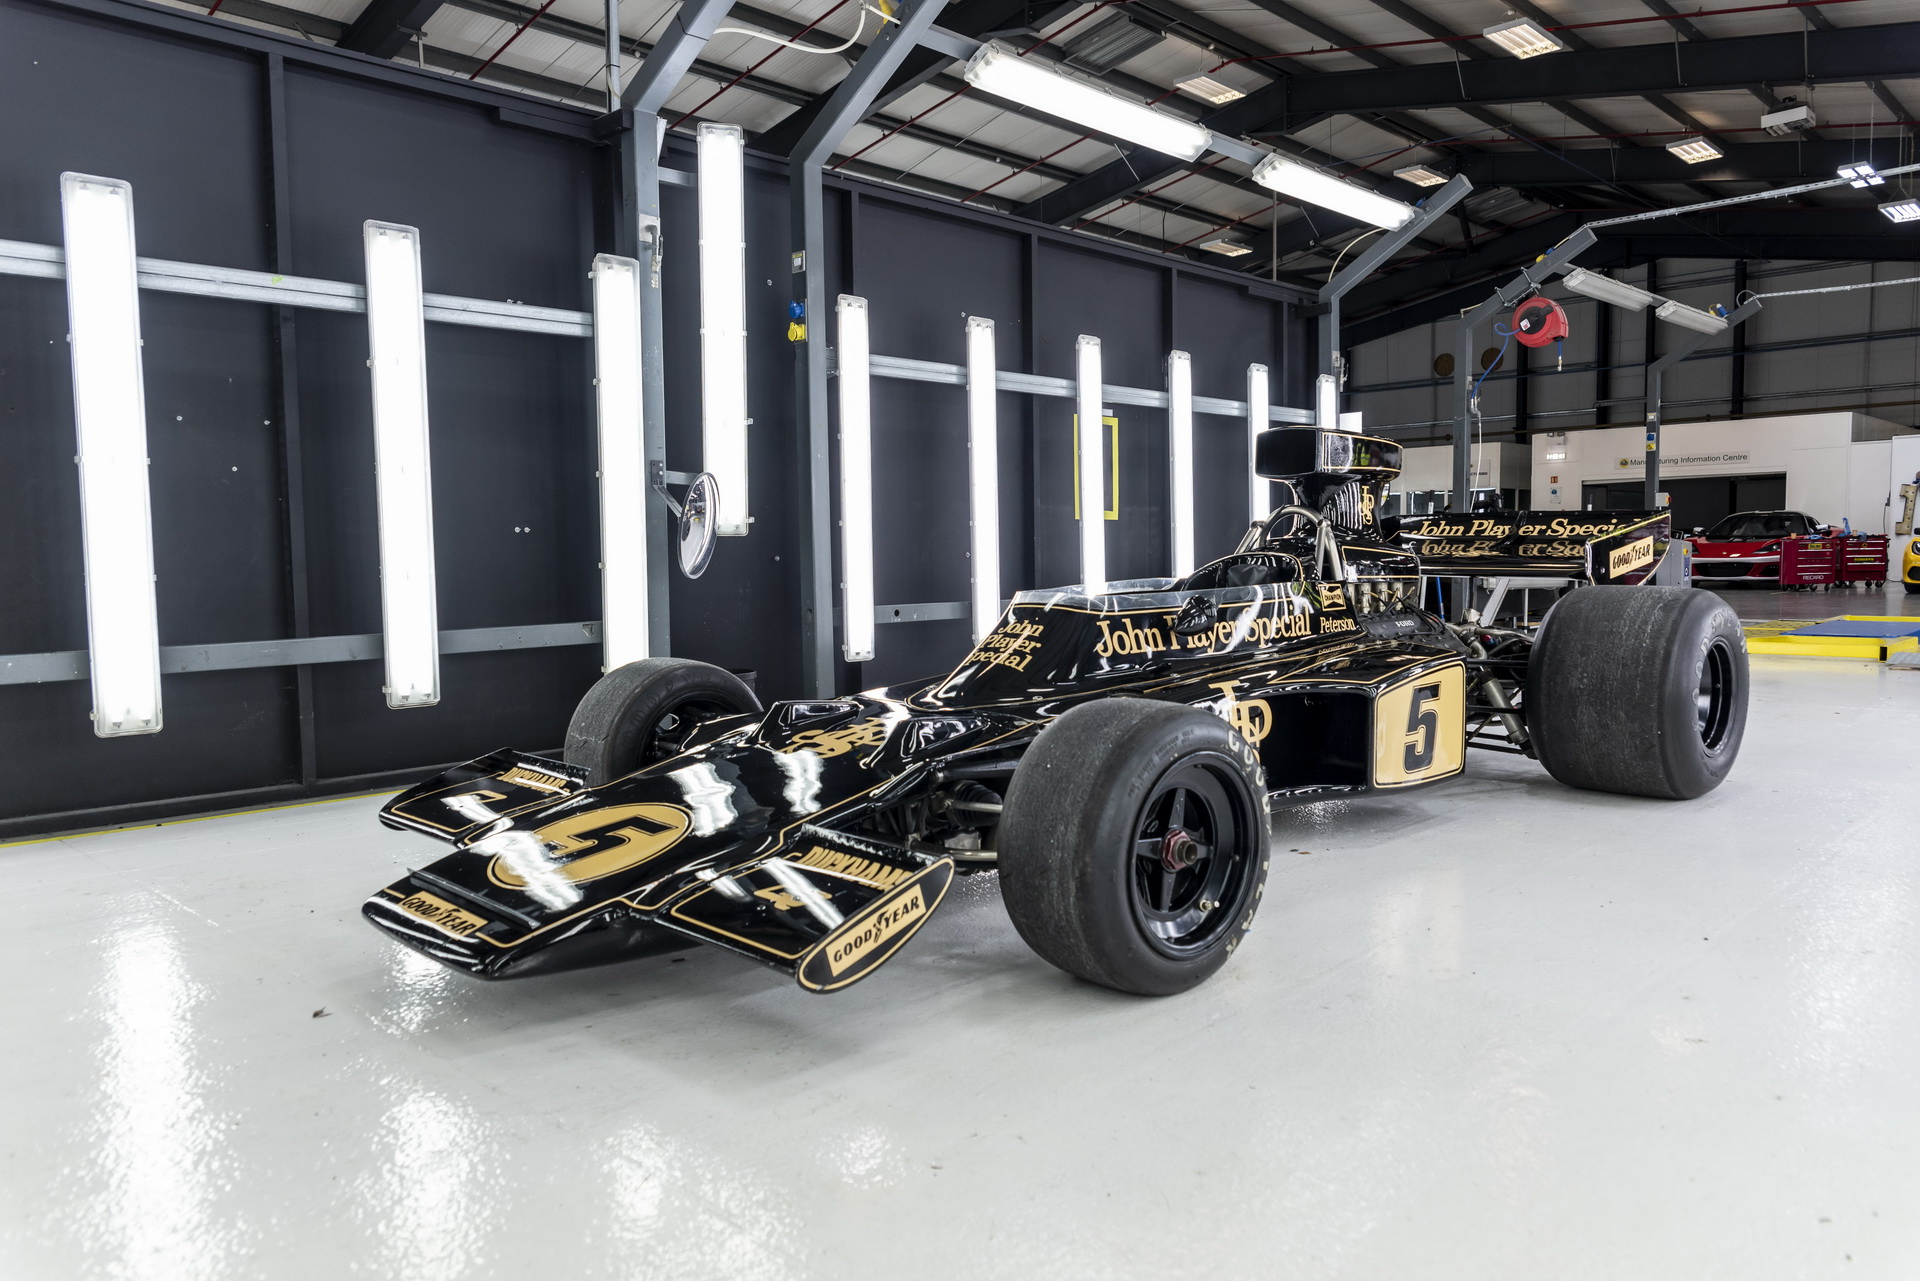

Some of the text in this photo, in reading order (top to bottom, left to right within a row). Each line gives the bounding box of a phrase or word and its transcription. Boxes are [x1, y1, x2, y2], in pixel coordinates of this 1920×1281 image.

[1630, 454, 1748, 466] Manturing Information Centre
[1411, 520, 1465, 537] John
[1546, 518, 1642, 539] Speci
[997, 619, 1045, 637] John
[1092, 604, 1313, 657] John Payer Special
[1319, 616, 1357, 634] Peterson
[1394, 619, 1415, 628] FORD
[979, 633, 1042, 653] Player
[964, 650, 1033, 672] pecial
[1403, 681, 1442, 775] 5
[538, 813, 680, 869] 5
